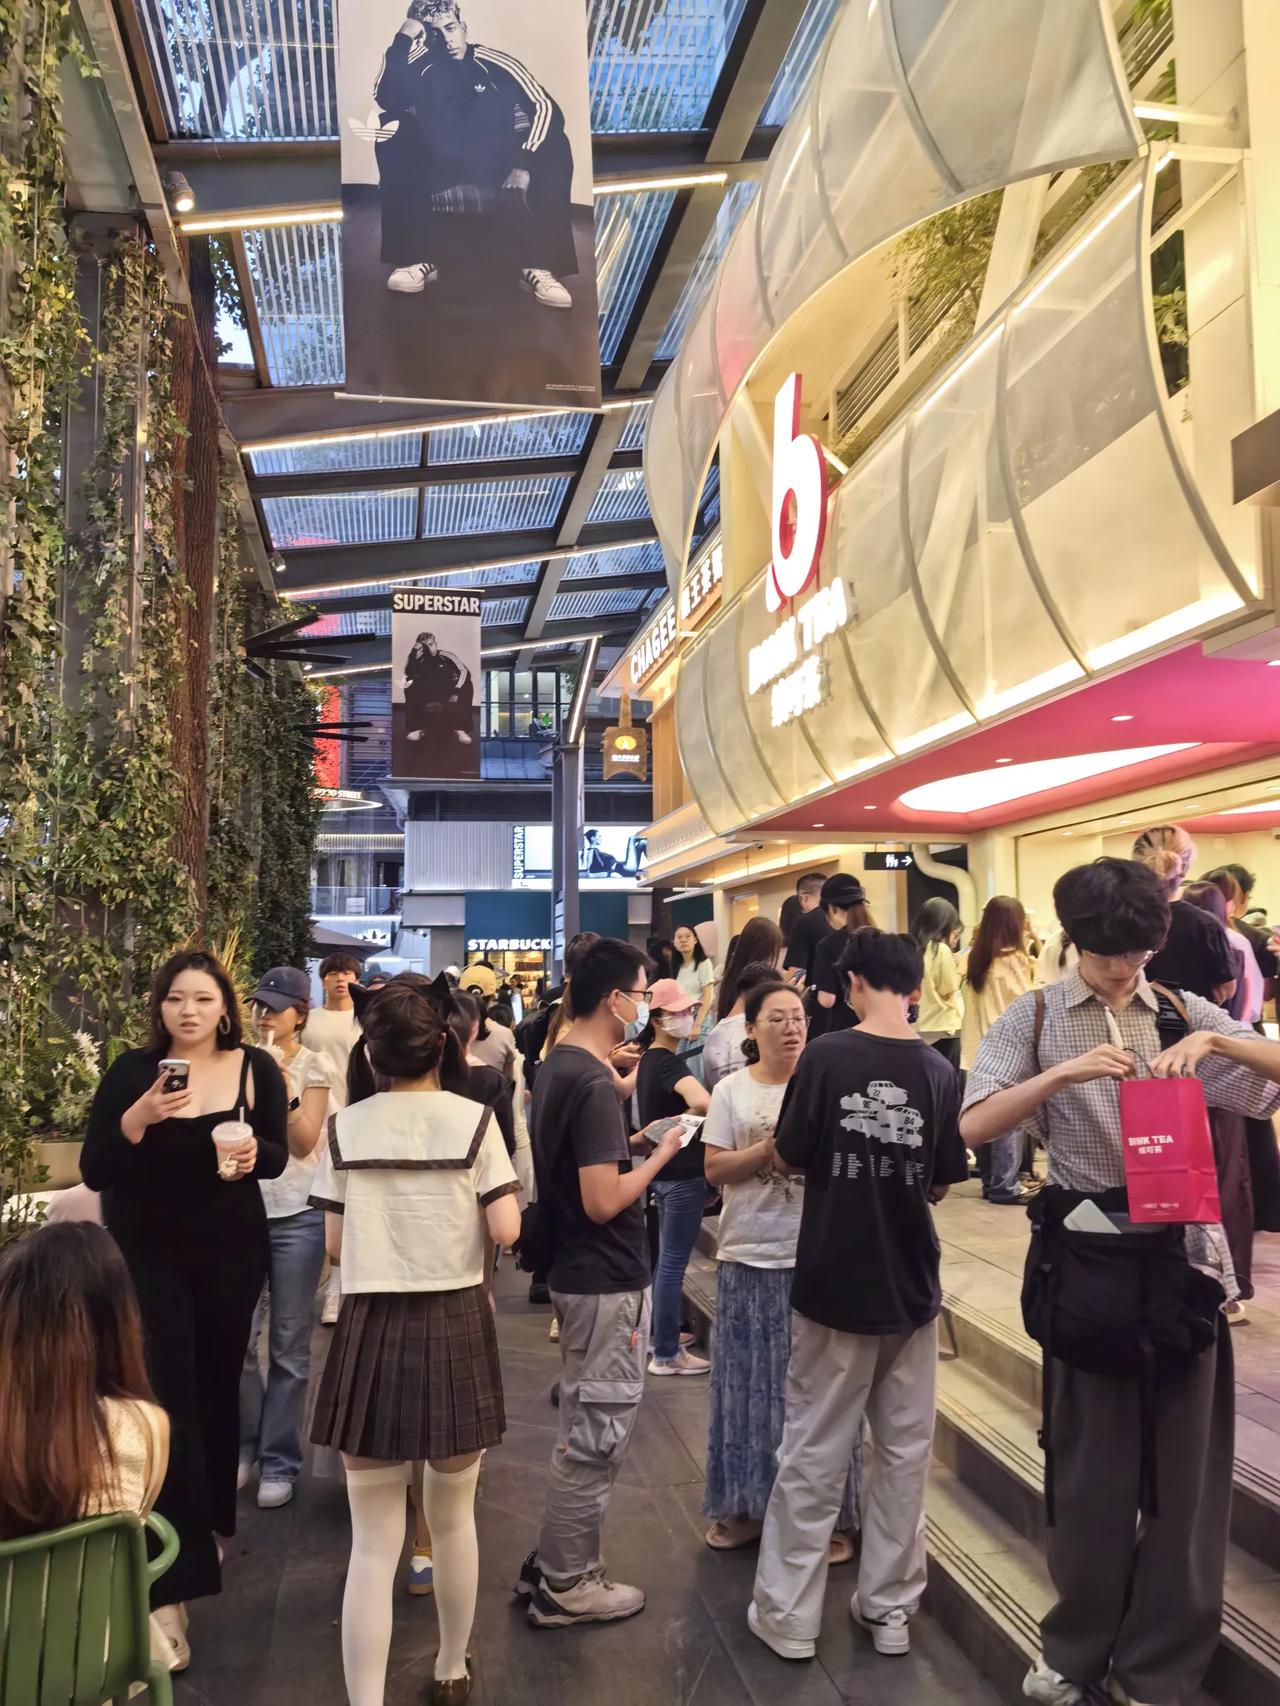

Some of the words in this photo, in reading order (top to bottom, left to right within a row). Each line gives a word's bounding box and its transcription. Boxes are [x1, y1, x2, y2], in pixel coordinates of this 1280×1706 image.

[393, 593, 480, 613] SUPERSTAR
[630, 605, 677, 684] CHAGEE
[513, 826, 525, 879] SUPERSTAR
[467, 938, 553, 951] STARBUCK
[1152, 1135, 1173, 1143] TEA
